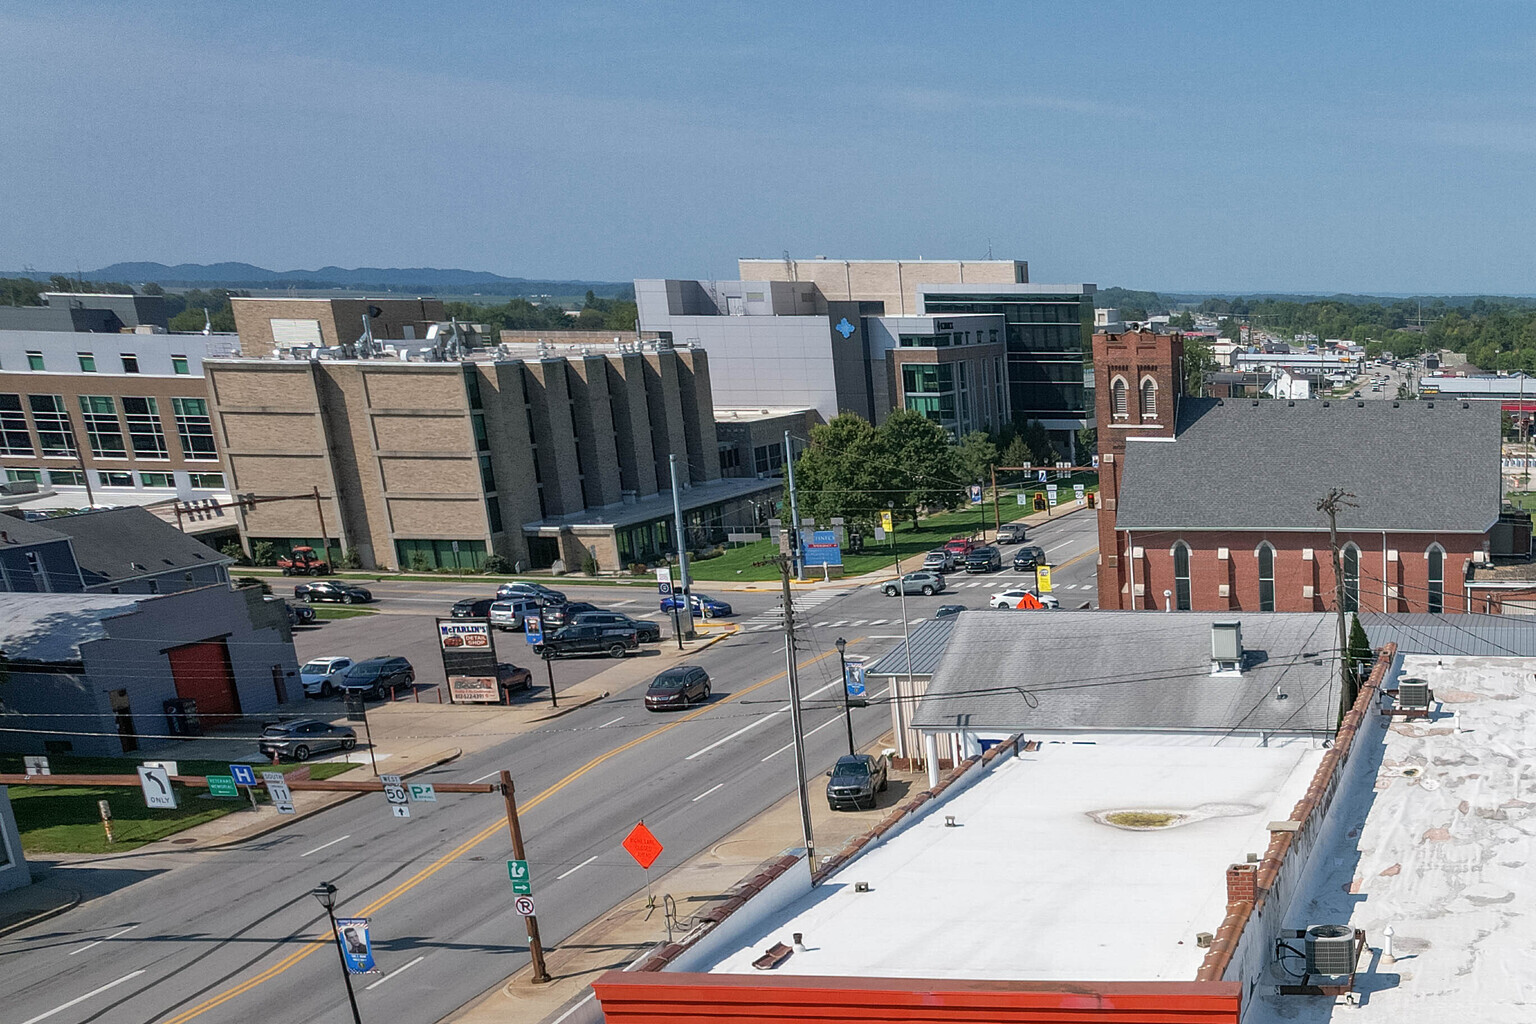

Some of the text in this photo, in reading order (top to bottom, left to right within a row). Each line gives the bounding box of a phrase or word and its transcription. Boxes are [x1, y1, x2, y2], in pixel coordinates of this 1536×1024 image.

[235, 768, 251, 782] H
[274, 789, 287, 799] 11
[387, 789, 404, 800] 50
